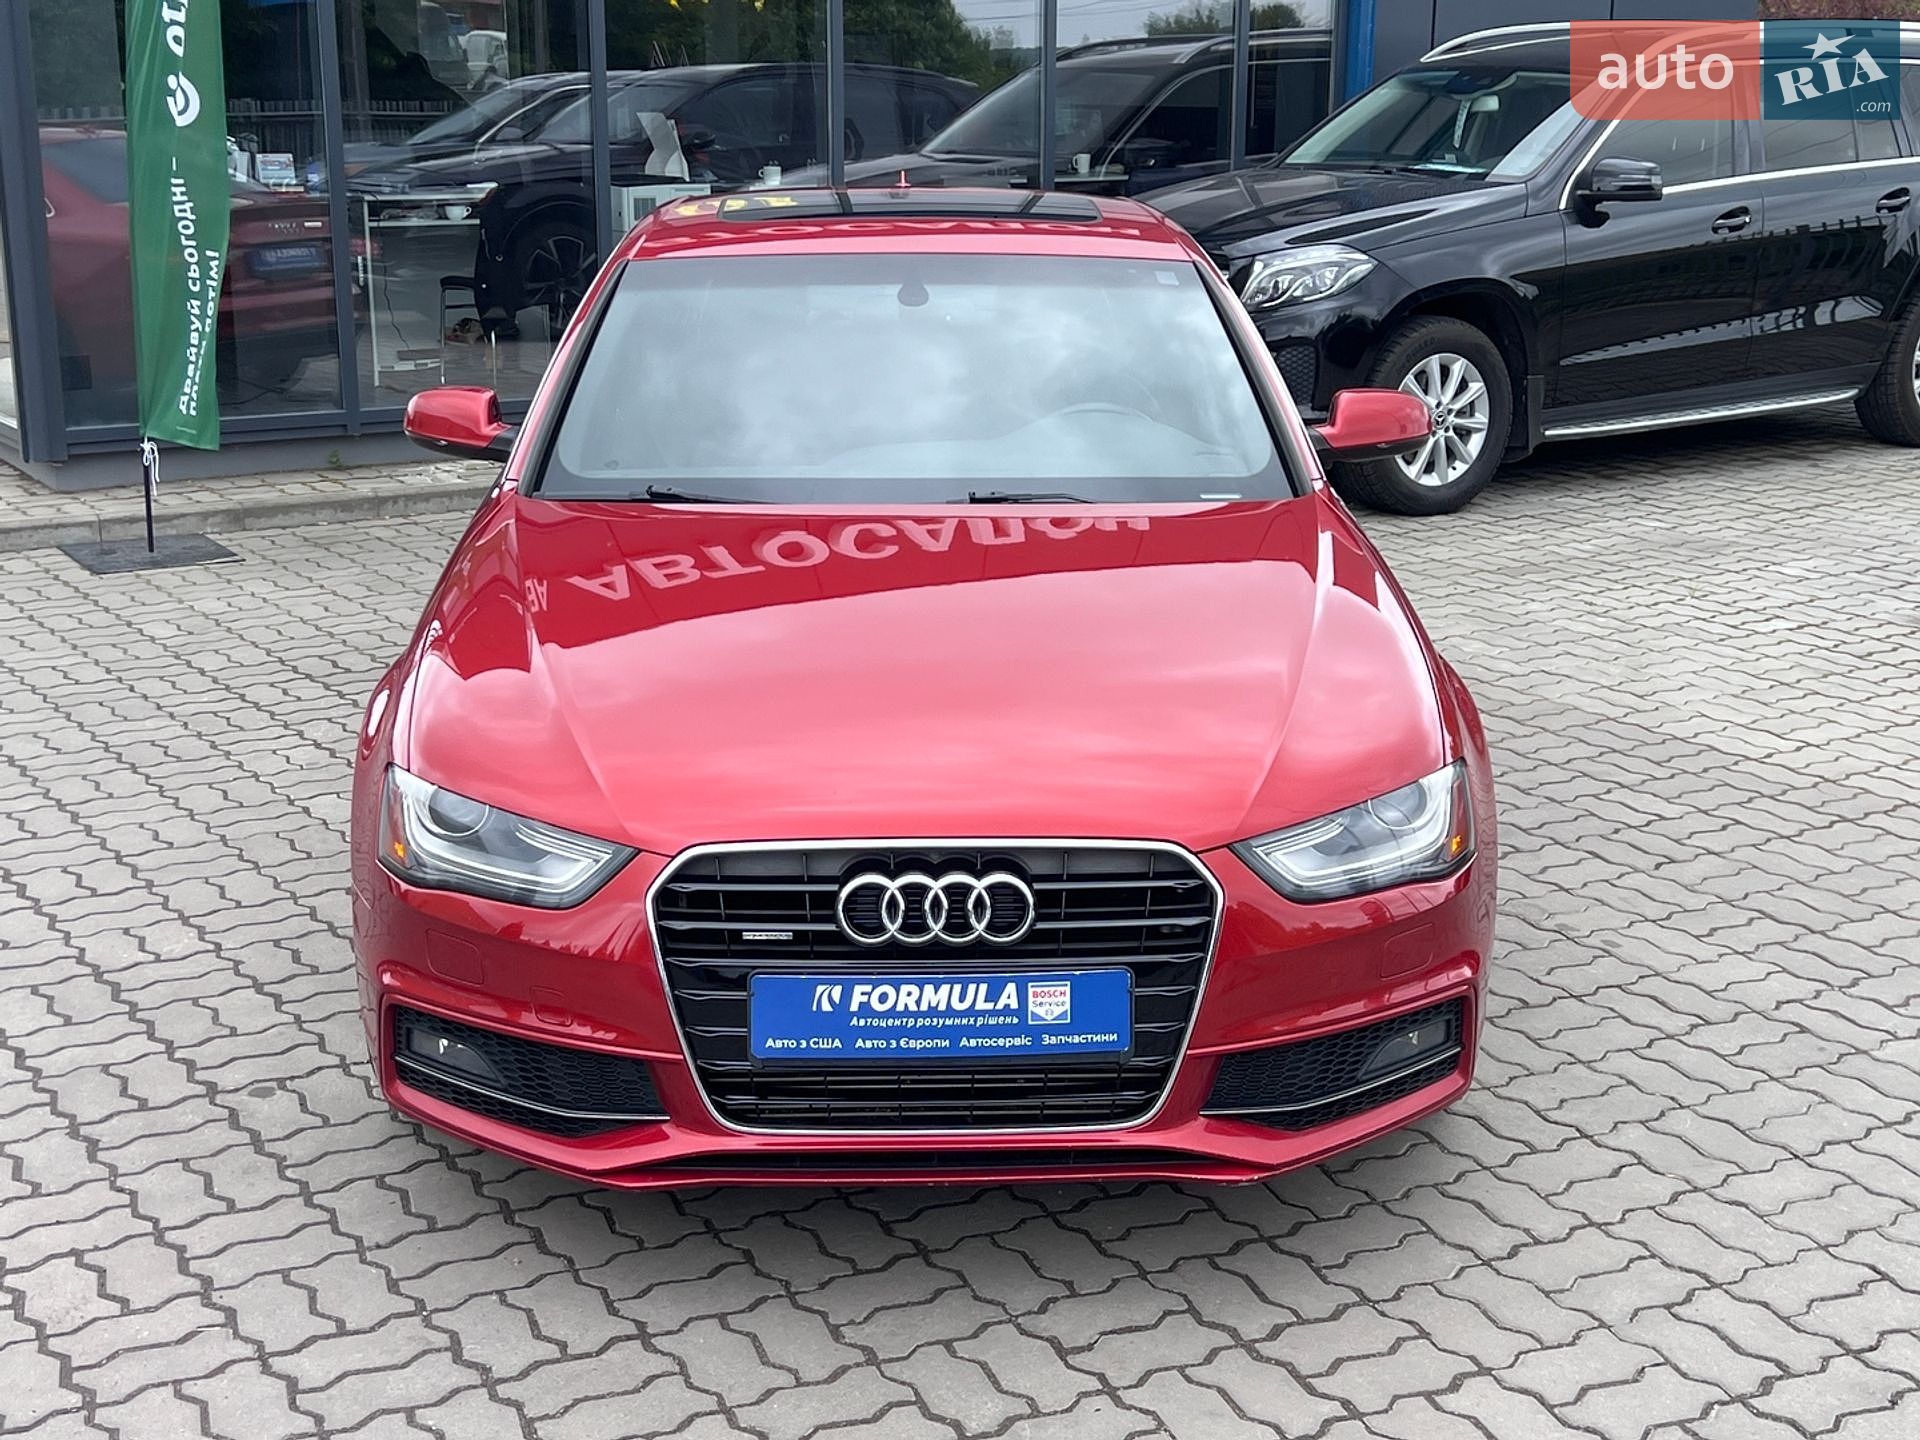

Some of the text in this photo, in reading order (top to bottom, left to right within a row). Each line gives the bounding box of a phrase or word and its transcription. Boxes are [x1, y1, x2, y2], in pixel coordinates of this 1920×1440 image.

[170, 178, 201, 292] сьогодні
[849, 982, 1019, 1012] FORMULA
[1032, 989, 1067, 999] BOSCH
[1032, 1000, 1067, 1008] Service
[976, 1014, 1019, 1027] рішень
[765, 1033, 1118, 1050] Авто з США Авто з Європи Автосервіс Запчастини
